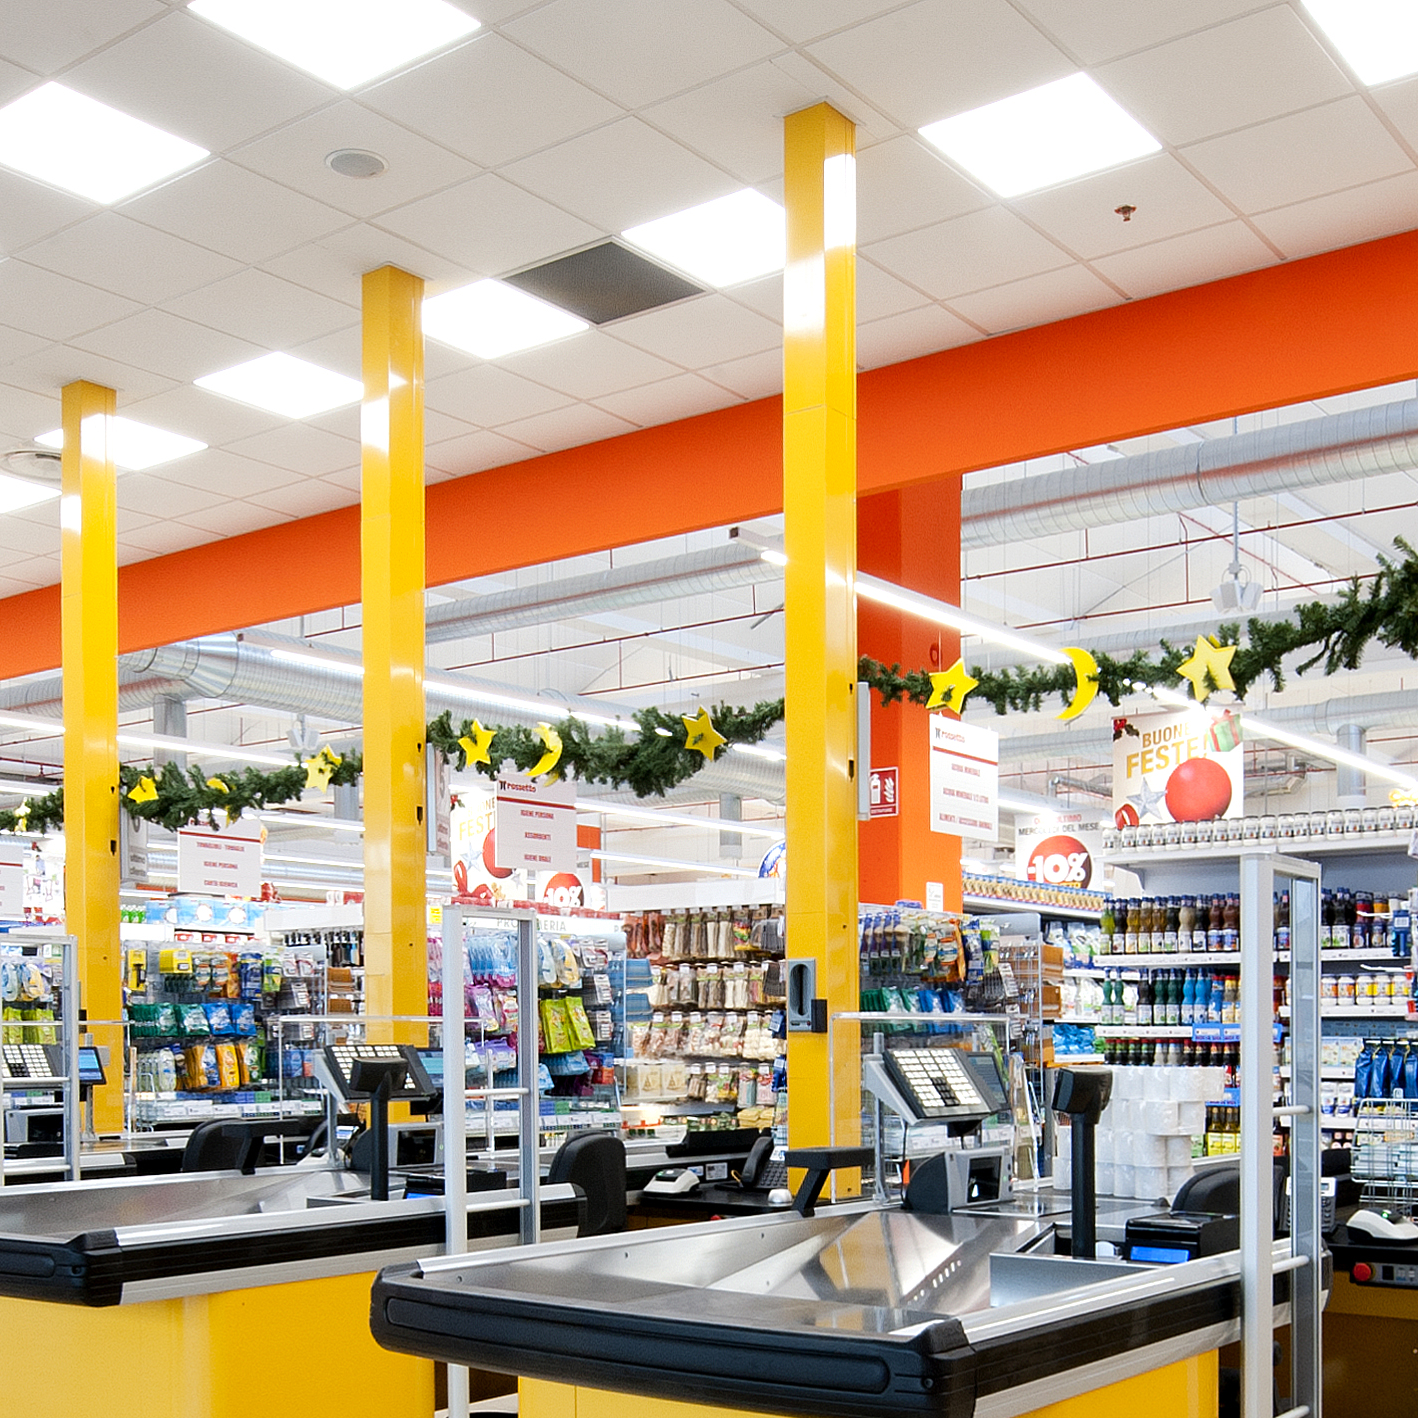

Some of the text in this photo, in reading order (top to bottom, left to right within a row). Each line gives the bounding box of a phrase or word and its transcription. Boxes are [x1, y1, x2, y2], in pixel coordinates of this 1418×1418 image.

[1142, 721, 1190, 748] BUONE
[507, 783, 536, 793] rossetto
[459, 811, 495, 841] FEST
[1027, 852, 1088, 883] -10%
